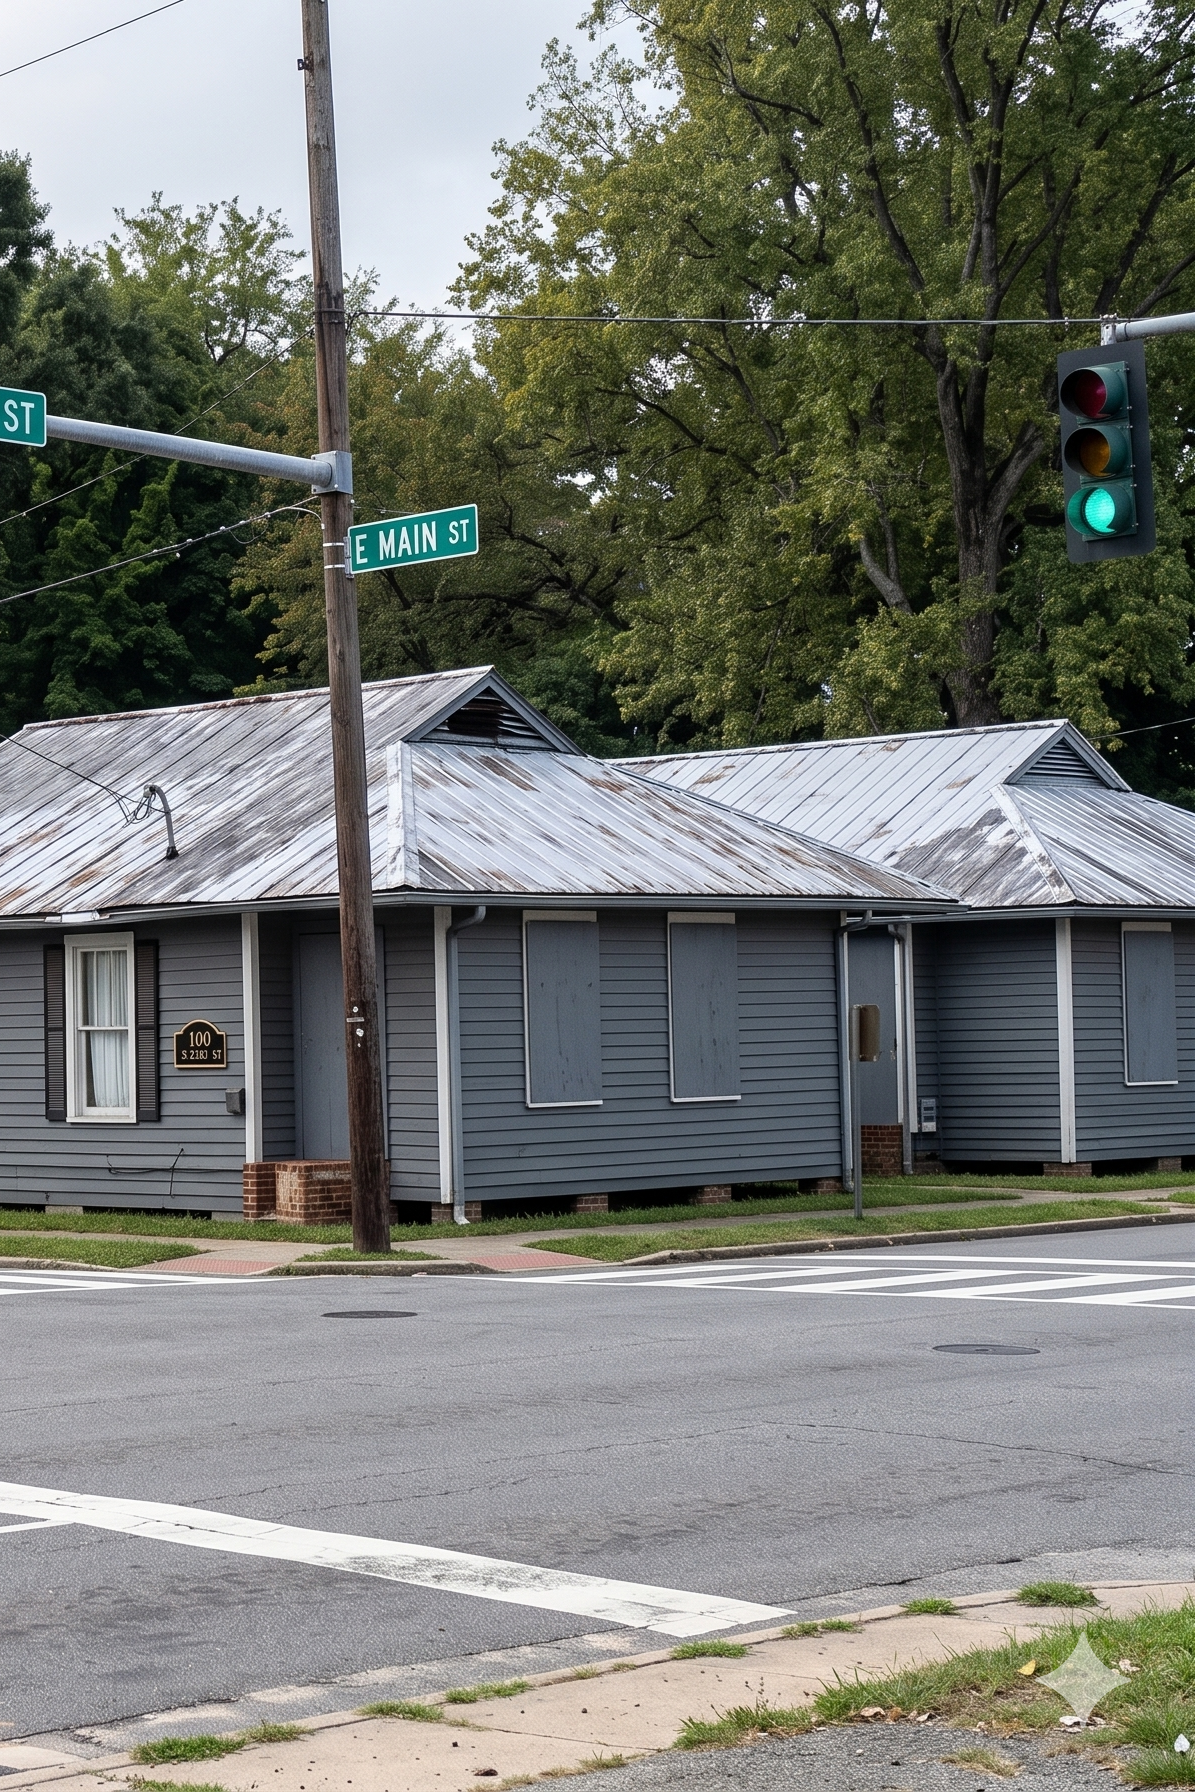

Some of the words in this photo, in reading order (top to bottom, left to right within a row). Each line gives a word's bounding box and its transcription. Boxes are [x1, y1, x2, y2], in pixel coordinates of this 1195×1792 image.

[3, 399, 35, 434] ST
[355, 533, 368, 564] E
[378, 521, 437, 561] MAIN
[448, 519, 470, 544] ST
[189, 1031, 211, 1047] 100
[212, 1049, 222, 1060] ST
